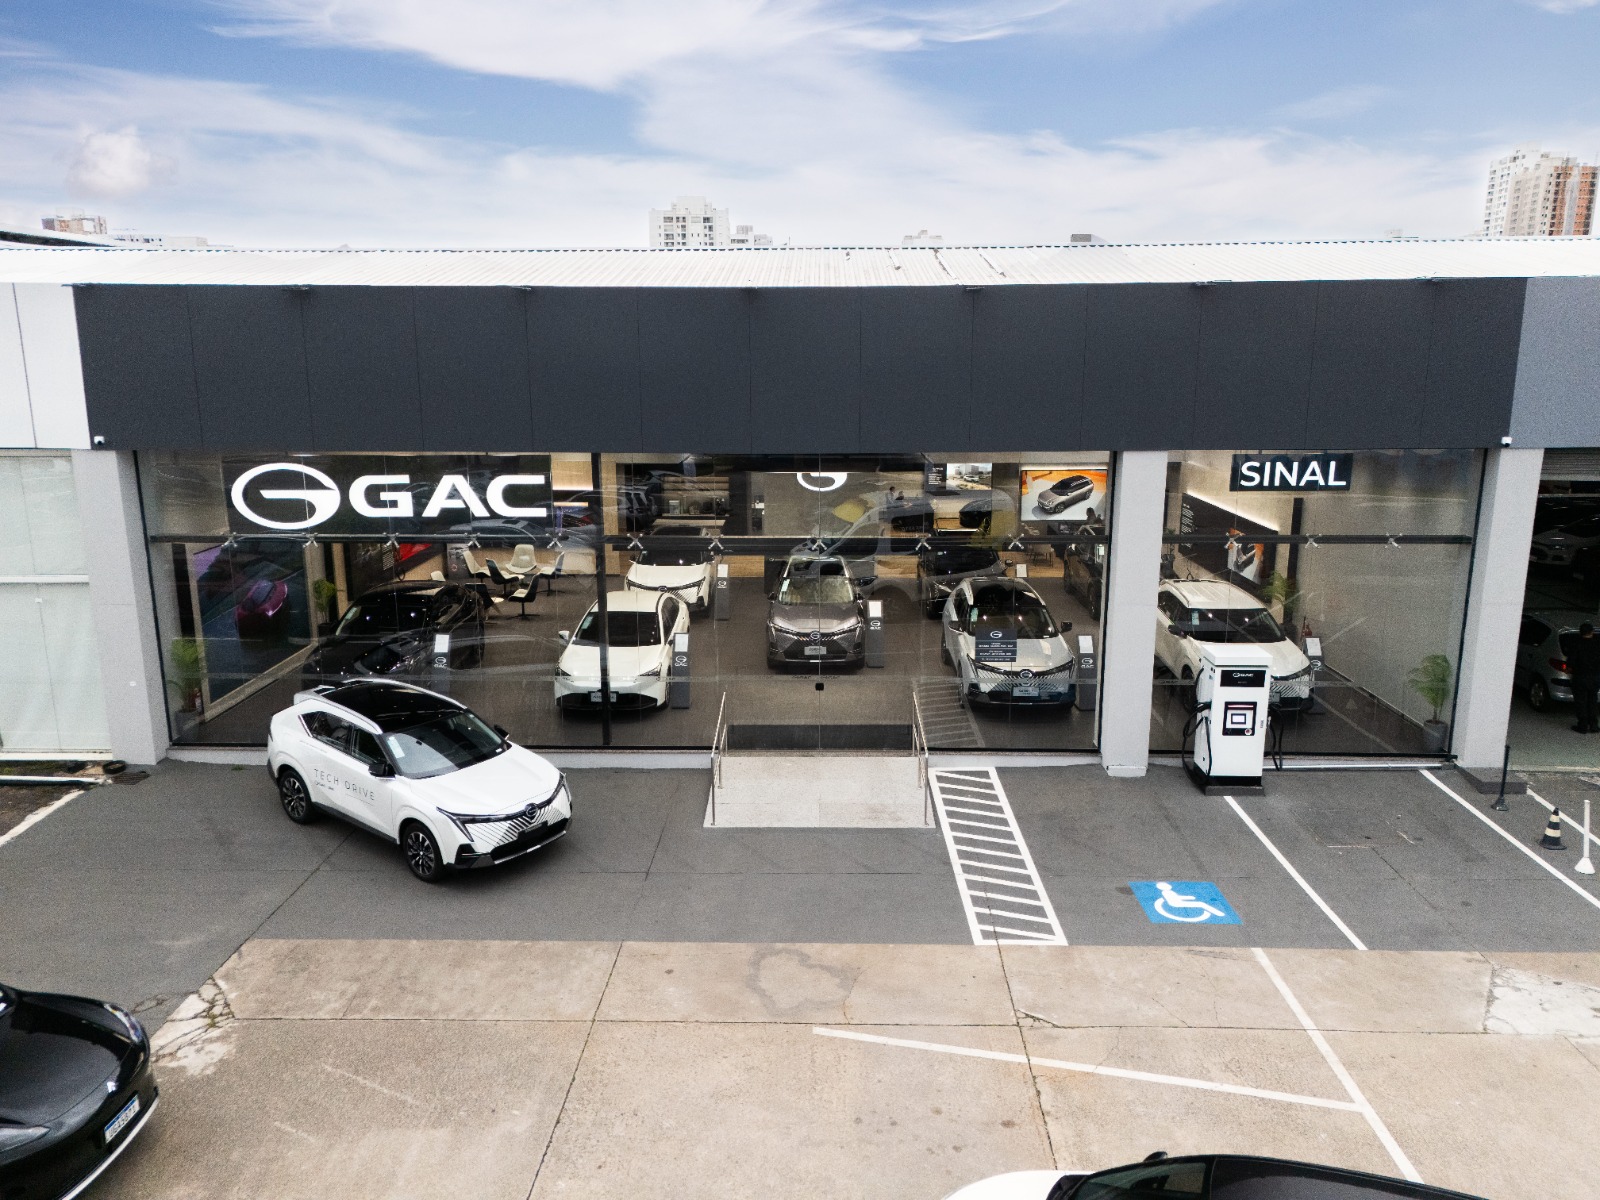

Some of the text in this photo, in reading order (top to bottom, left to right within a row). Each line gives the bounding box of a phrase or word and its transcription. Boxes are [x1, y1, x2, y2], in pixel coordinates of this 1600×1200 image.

[1240, 460, 1347, 487] SINAL
[348, 474, 548, 518] GAC
[313, 768, 339, 786] TECH
[344, 780, 375, 801] DRIVE
